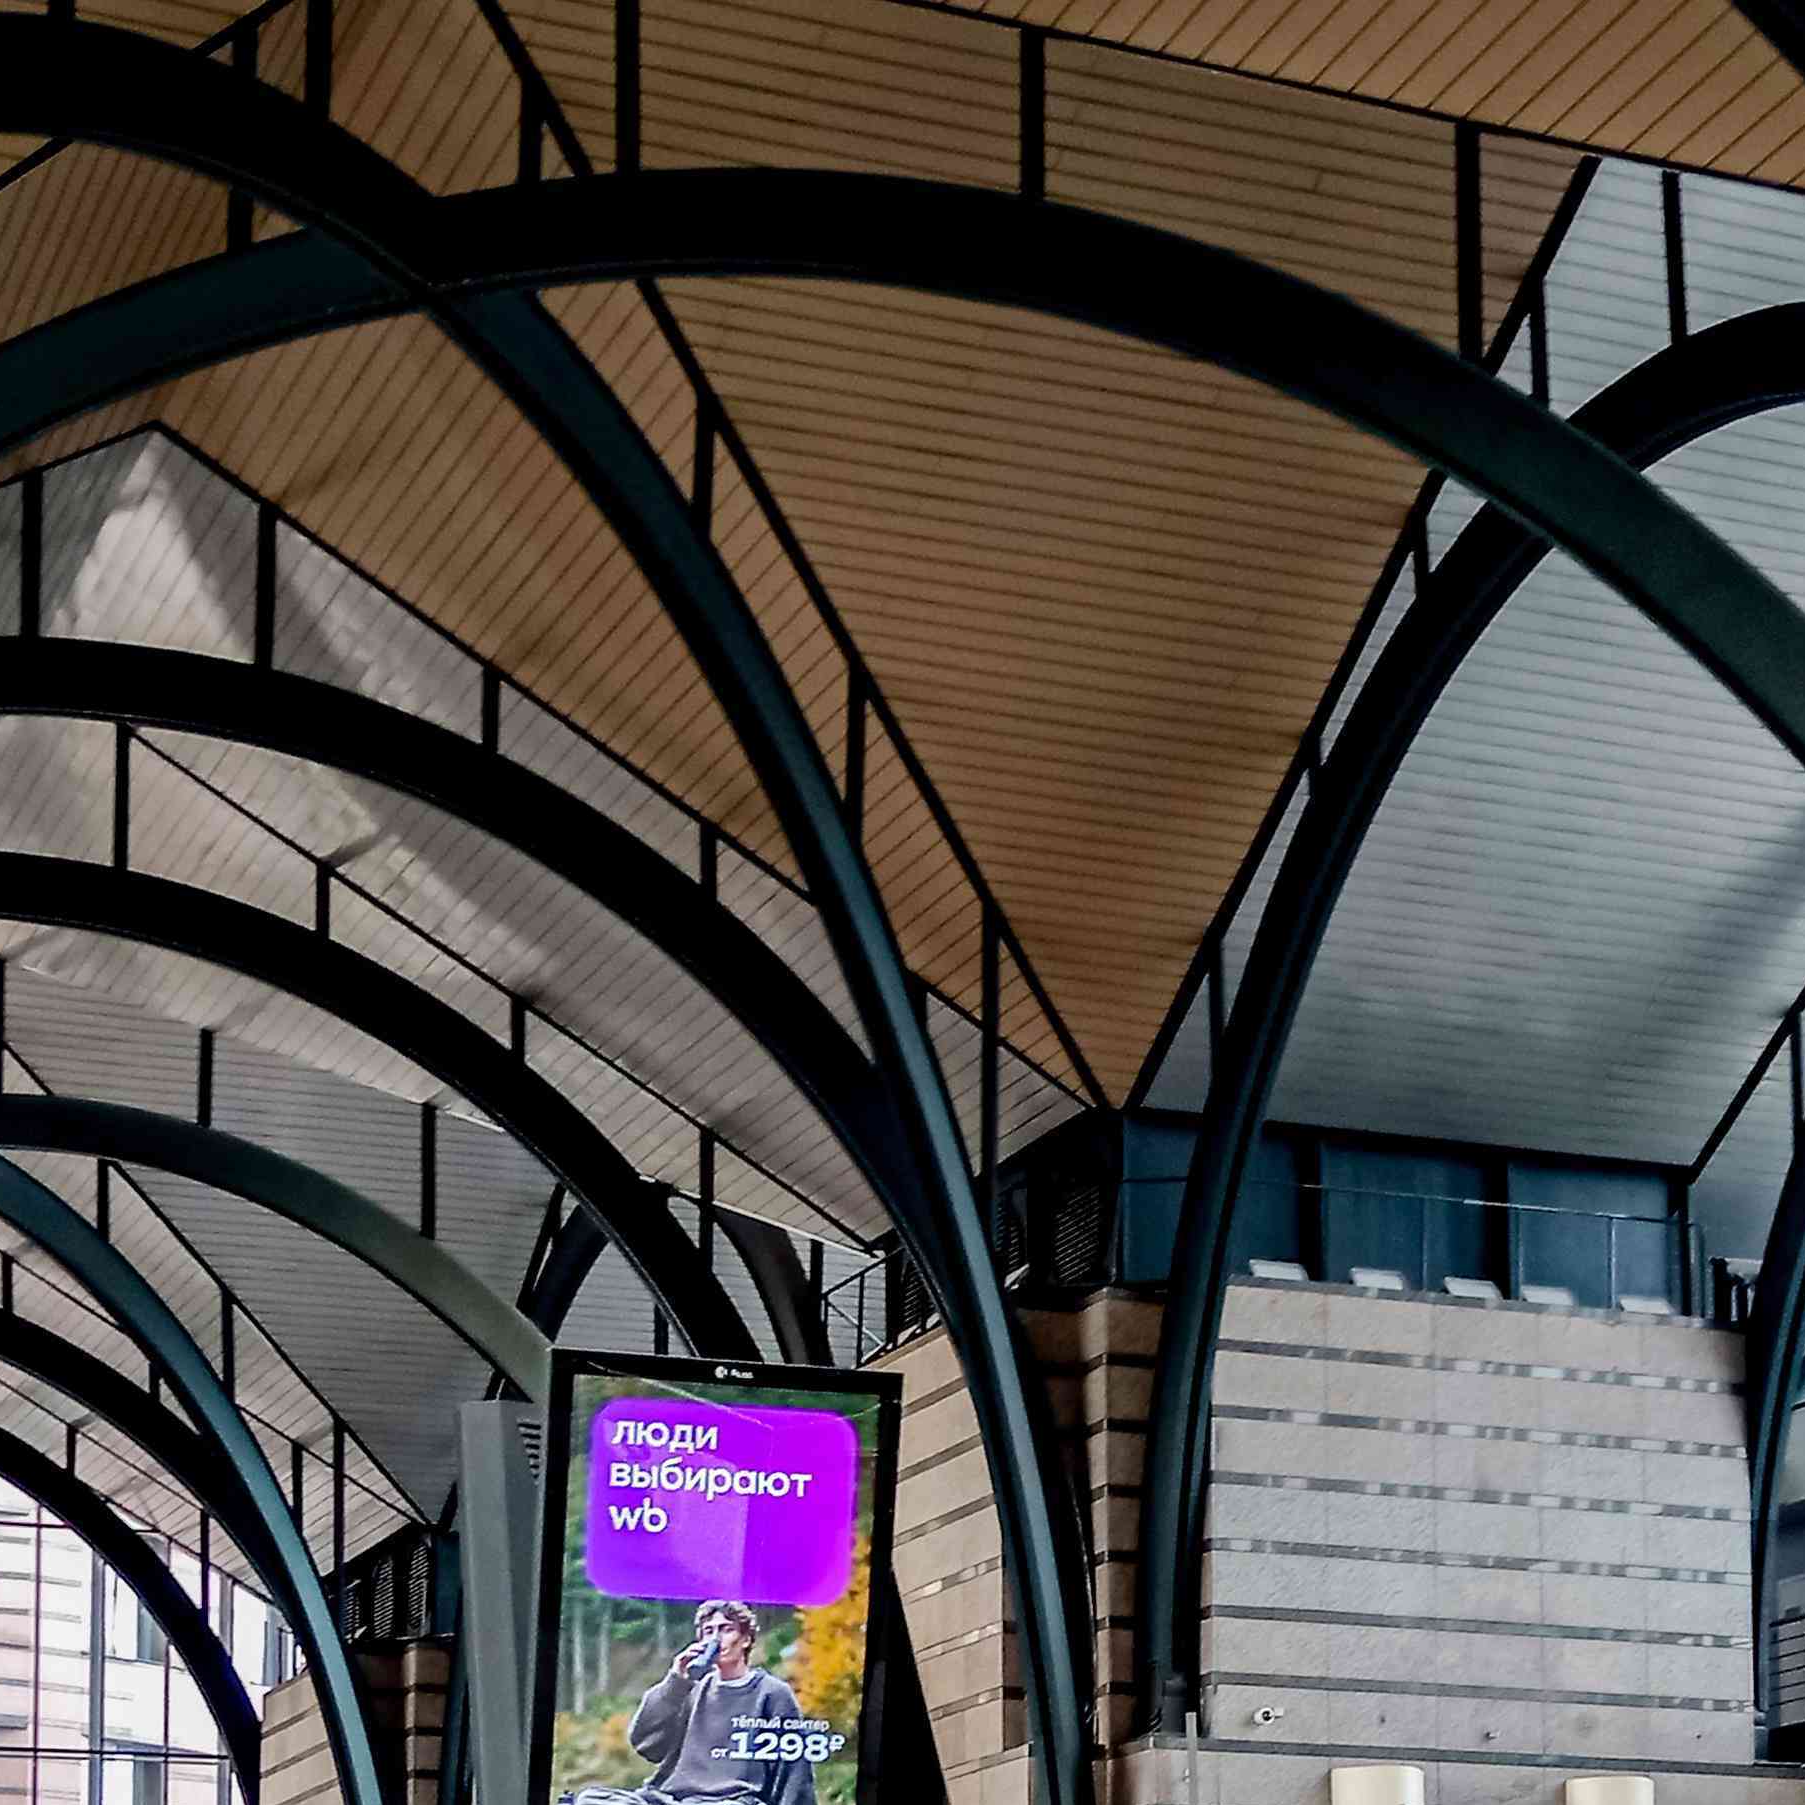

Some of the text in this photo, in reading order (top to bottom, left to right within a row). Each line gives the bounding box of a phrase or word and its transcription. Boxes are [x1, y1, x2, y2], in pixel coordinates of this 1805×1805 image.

[611, 1421, 718, 1453] люди
[610, 1457, 812, 1501] выбирают
[609, 1498, 668, 1532] wb
